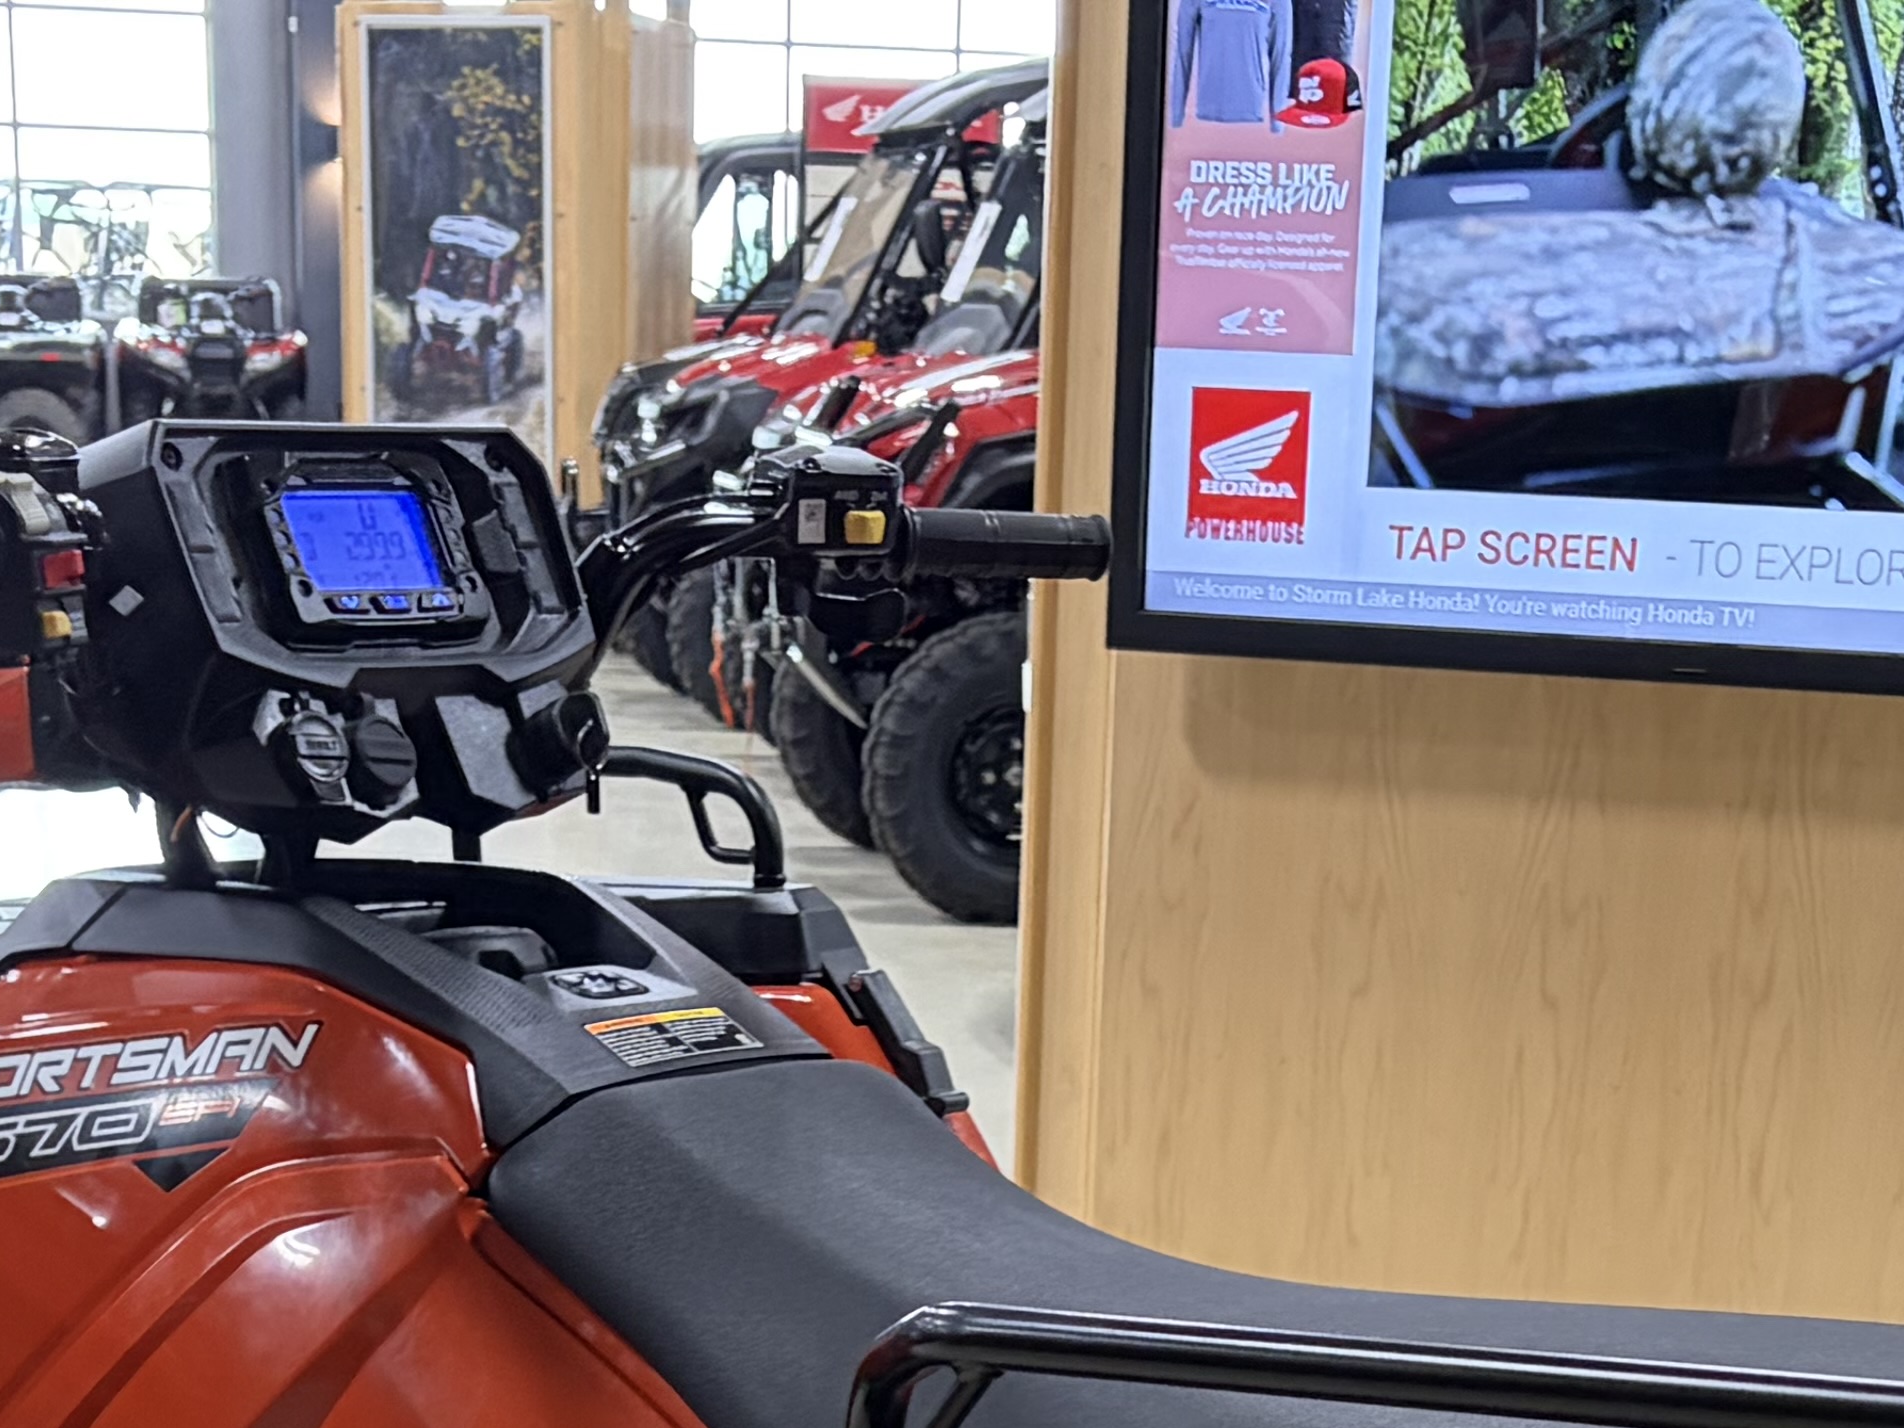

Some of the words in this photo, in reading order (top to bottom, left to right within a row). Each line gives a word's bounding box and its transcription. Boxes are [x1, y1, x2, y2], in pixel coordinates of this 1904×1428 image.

[1190, 160, 1272, 185] DRESS
[1279, 162, 1336, 186] LIKE
[1173, 187, 1199, 222] A
[1202, 180, 1350, 219] CHAMPION
[1199, 478, 1298, 500] HONDA
[1184, 516, 1305, 546] POWERHOUSE
[1389, 524, 1466, 563] TAP
[1477, 530, 1638, 573] SCREEN
[1689, 539, 1742, 579] TO
[1174, 577, 1265, 601] Welcome
[1268, 583, 1289, 602] to
[1292, 583, 1353, 606] Storm
[1356, 587, 1405, 609] Lake
[1408, 590, 1480, 613] Honda!
[1484, 594, 1546, 618] You're
[1551, 599, 1643, 627] watching
[1648, 603, 1714, 627] Honda
[1721, 606, 1756, 628] TV!
